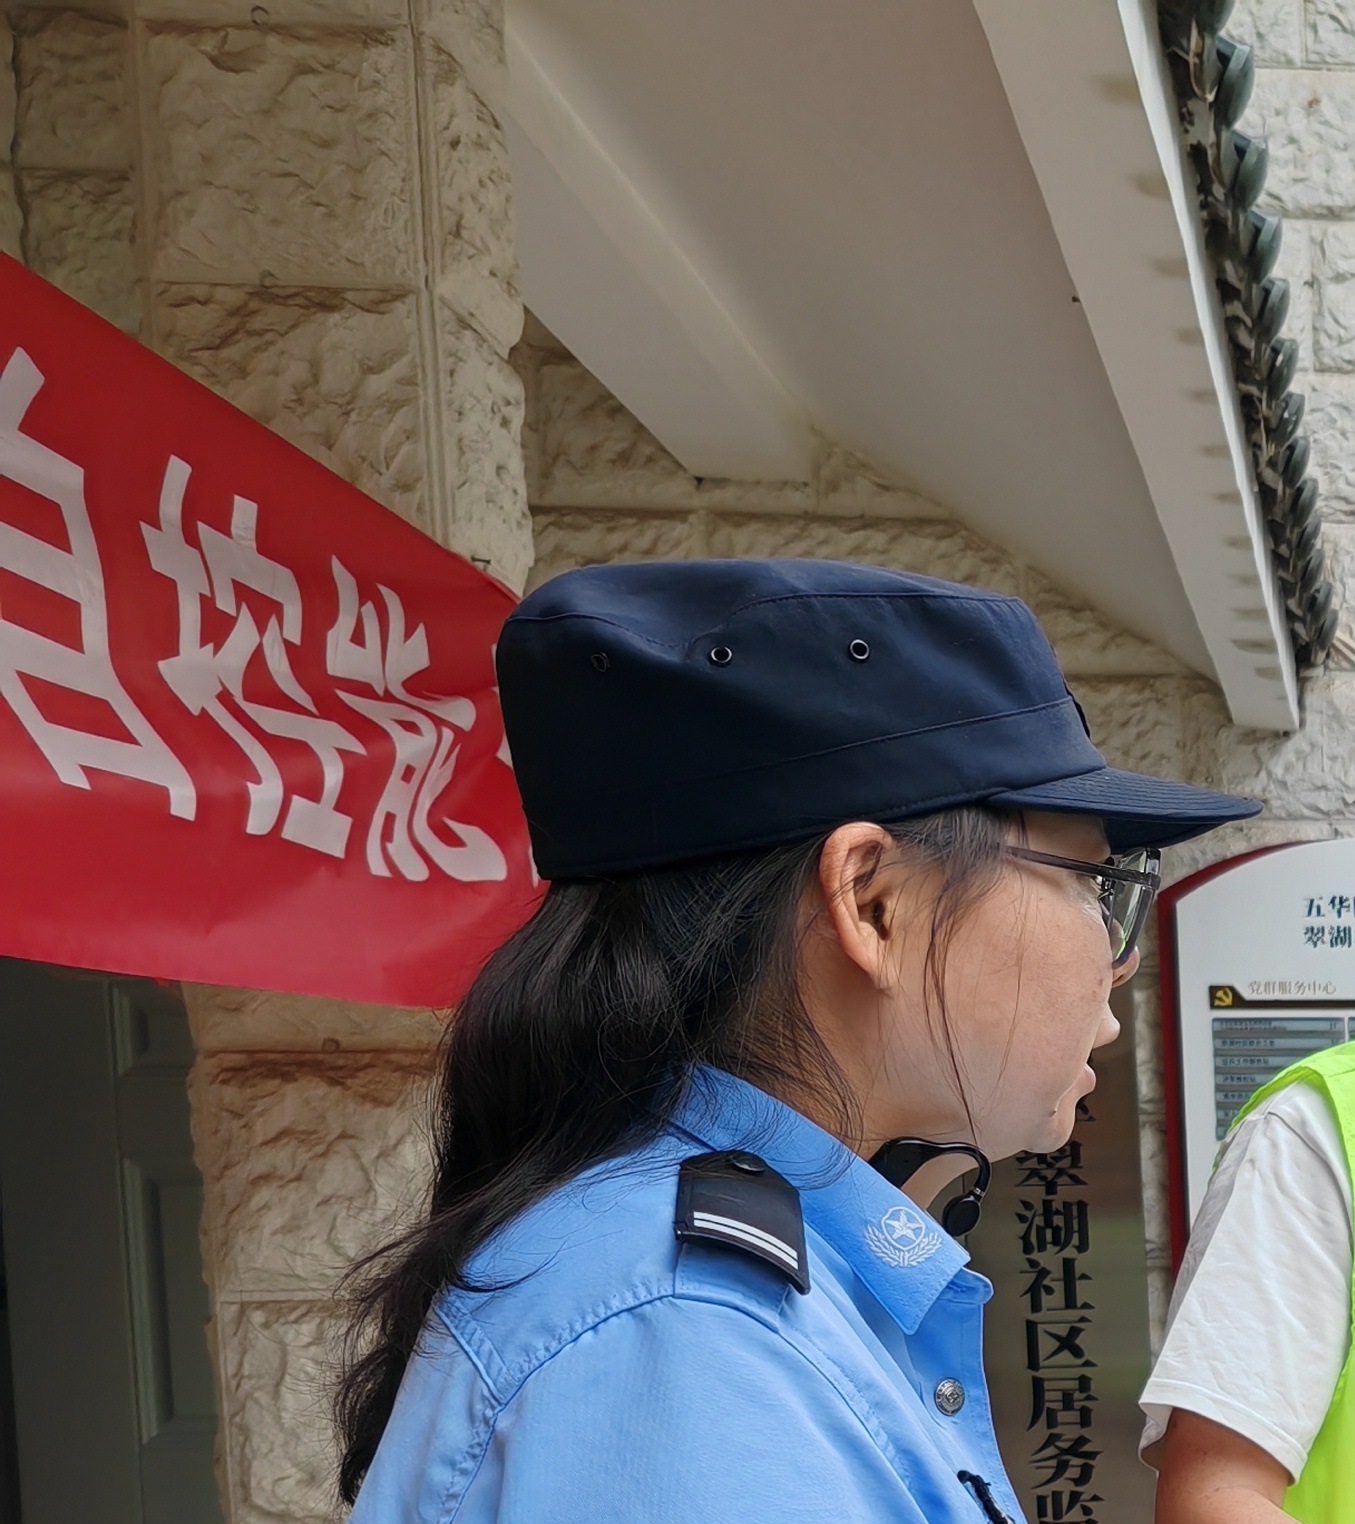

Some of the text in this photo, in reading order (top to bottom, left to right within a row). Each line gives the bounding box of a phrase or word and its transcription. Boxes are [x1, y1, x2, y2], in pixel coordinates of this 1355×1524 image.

[0, 346, 550, 888] 自控能
[1248, 980, 1336, 995] 党群服务中心
